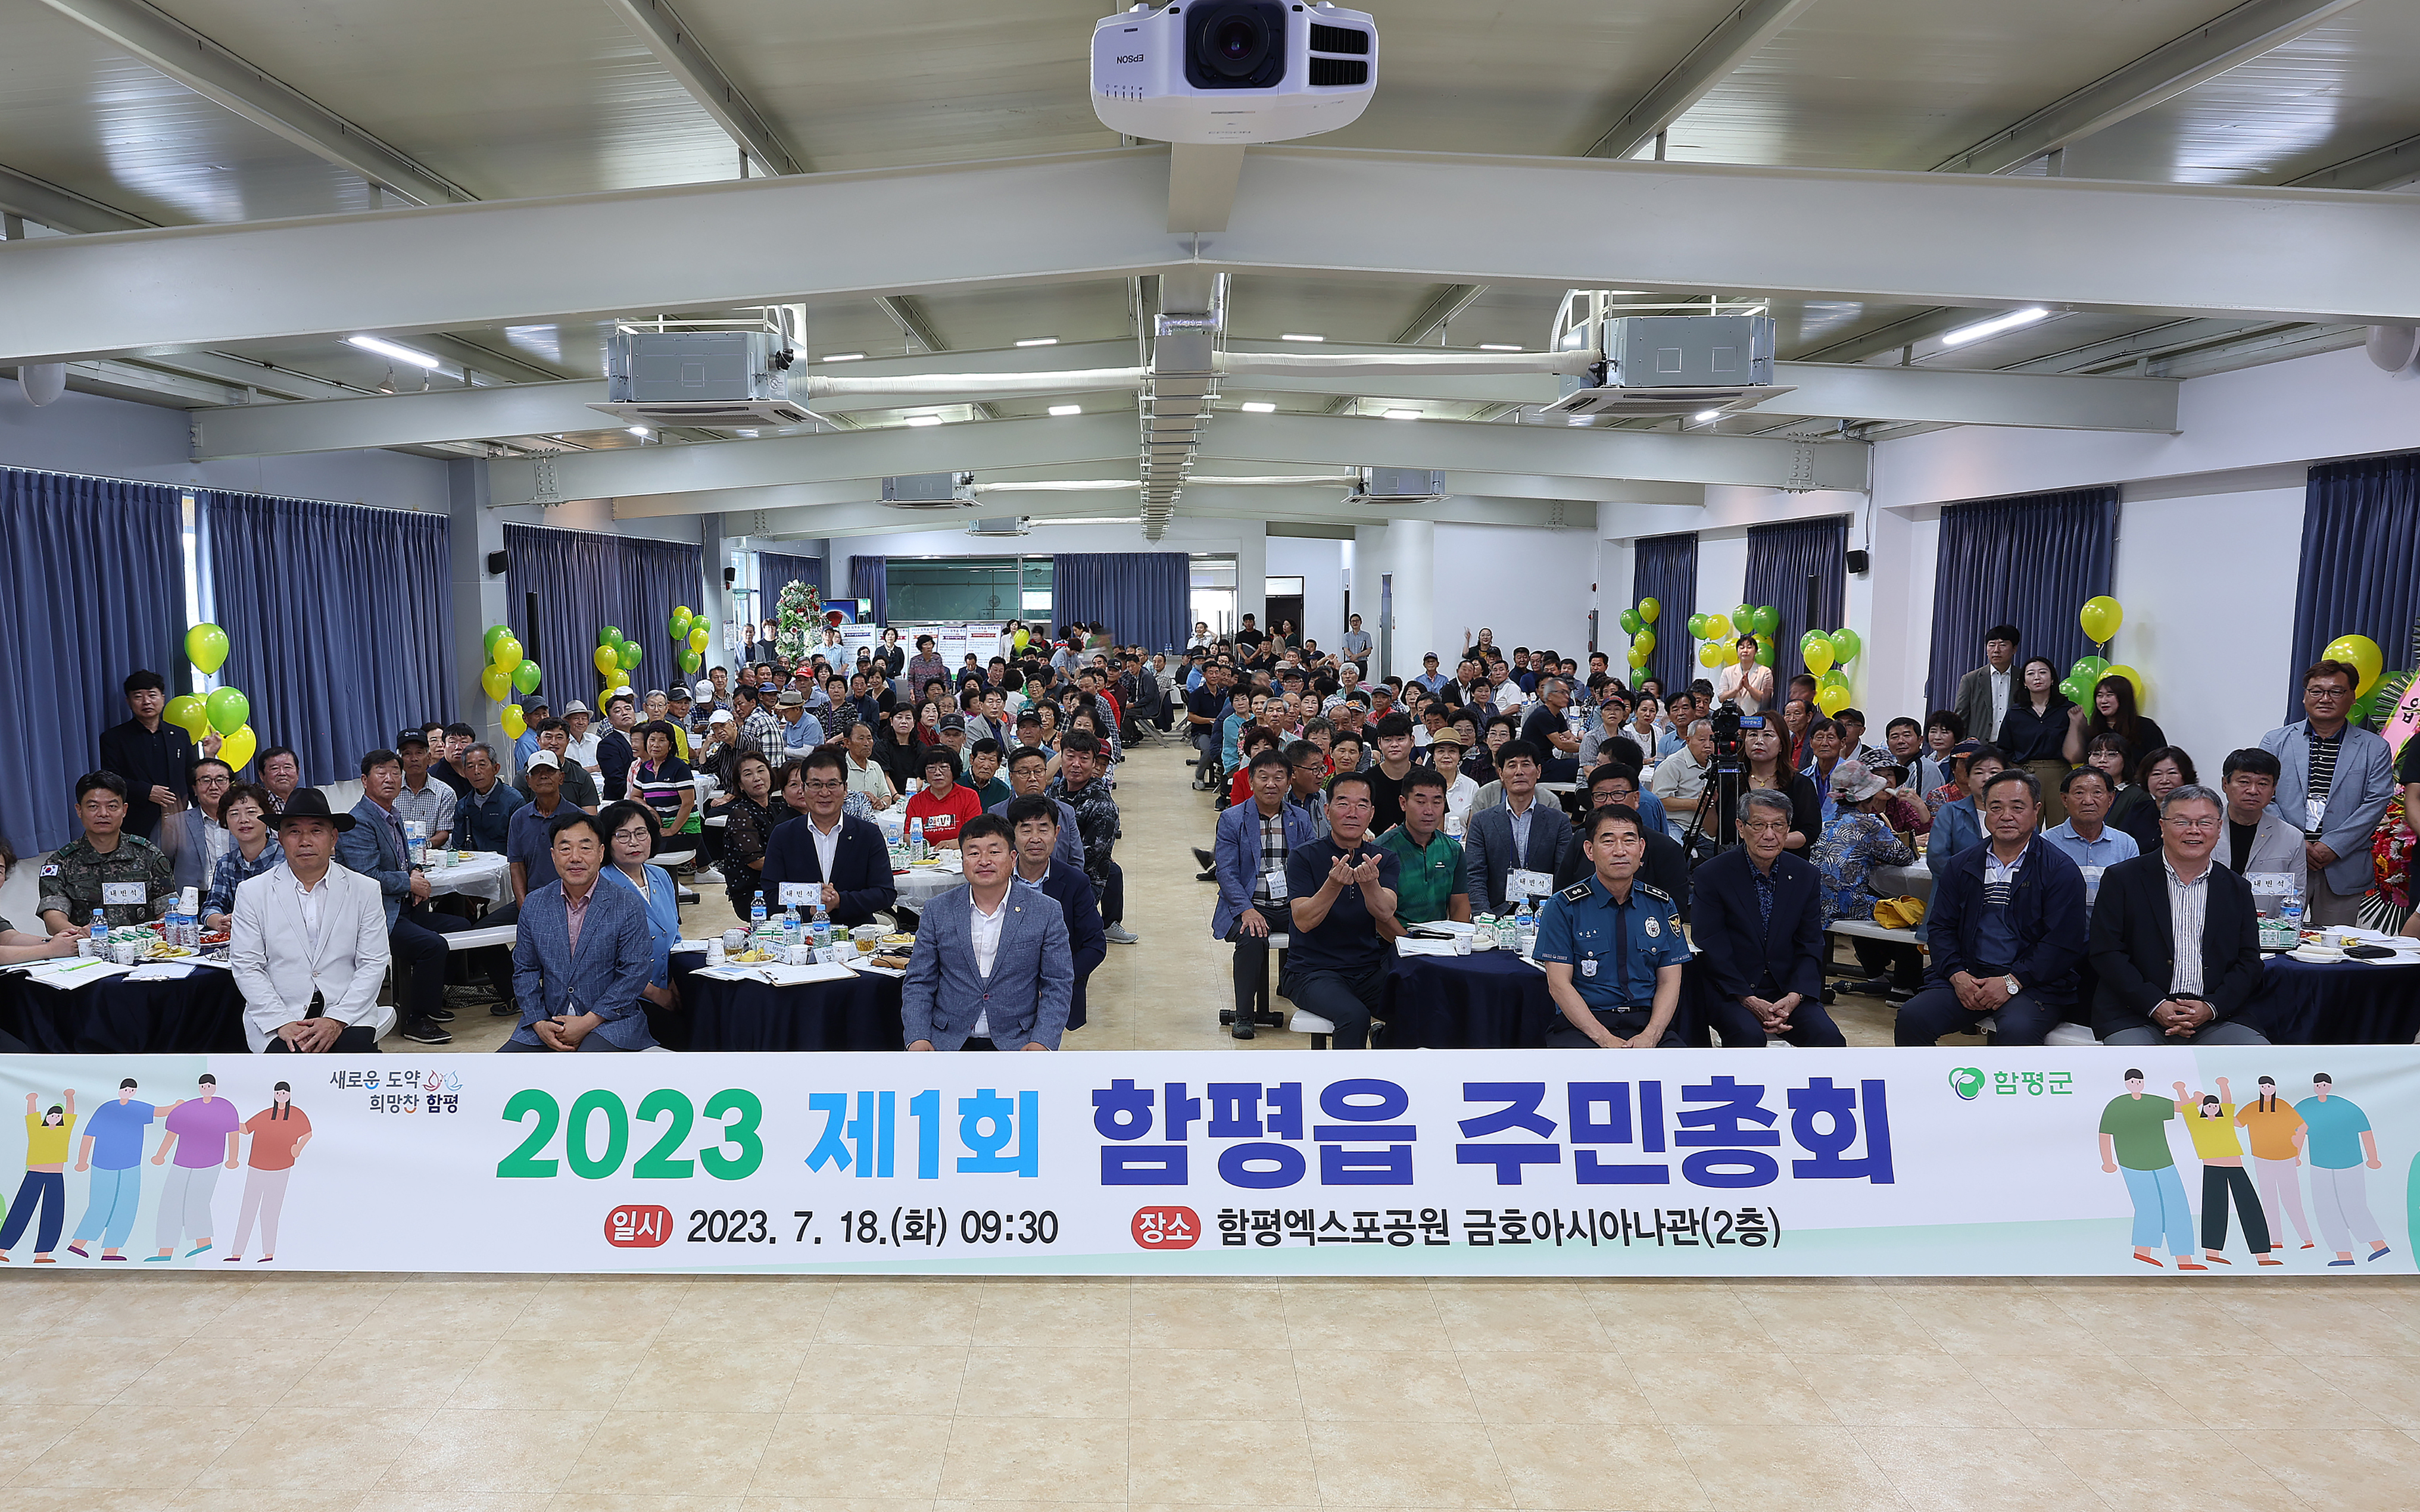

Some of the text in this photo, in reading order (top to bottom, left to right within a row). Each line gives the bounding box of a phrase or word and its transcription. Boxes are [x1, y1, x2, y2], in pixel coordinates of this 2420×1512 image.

[1117, 54, 1144, 64] EPSON
[330, 1070, 420, 1090] 새로운 도약
[1993, 1071, 2073, 1095] 함평군
[369, 1093, 459, 1114] 희망찬 함평
[497, 1075, 1895, 1189] 2023 제1회 함평읍 주민총회
[610, 1210, 663, 1242] 일시
[687, 1210, 776, 1244] 2023.
[794, 1211, 821, 1245] 7.
[960, 1210, 1059, 1244] 09:30
[1139, 1206, 1780, 1249] 장소 함평엑스포공원 금호아시아나관(2층)
